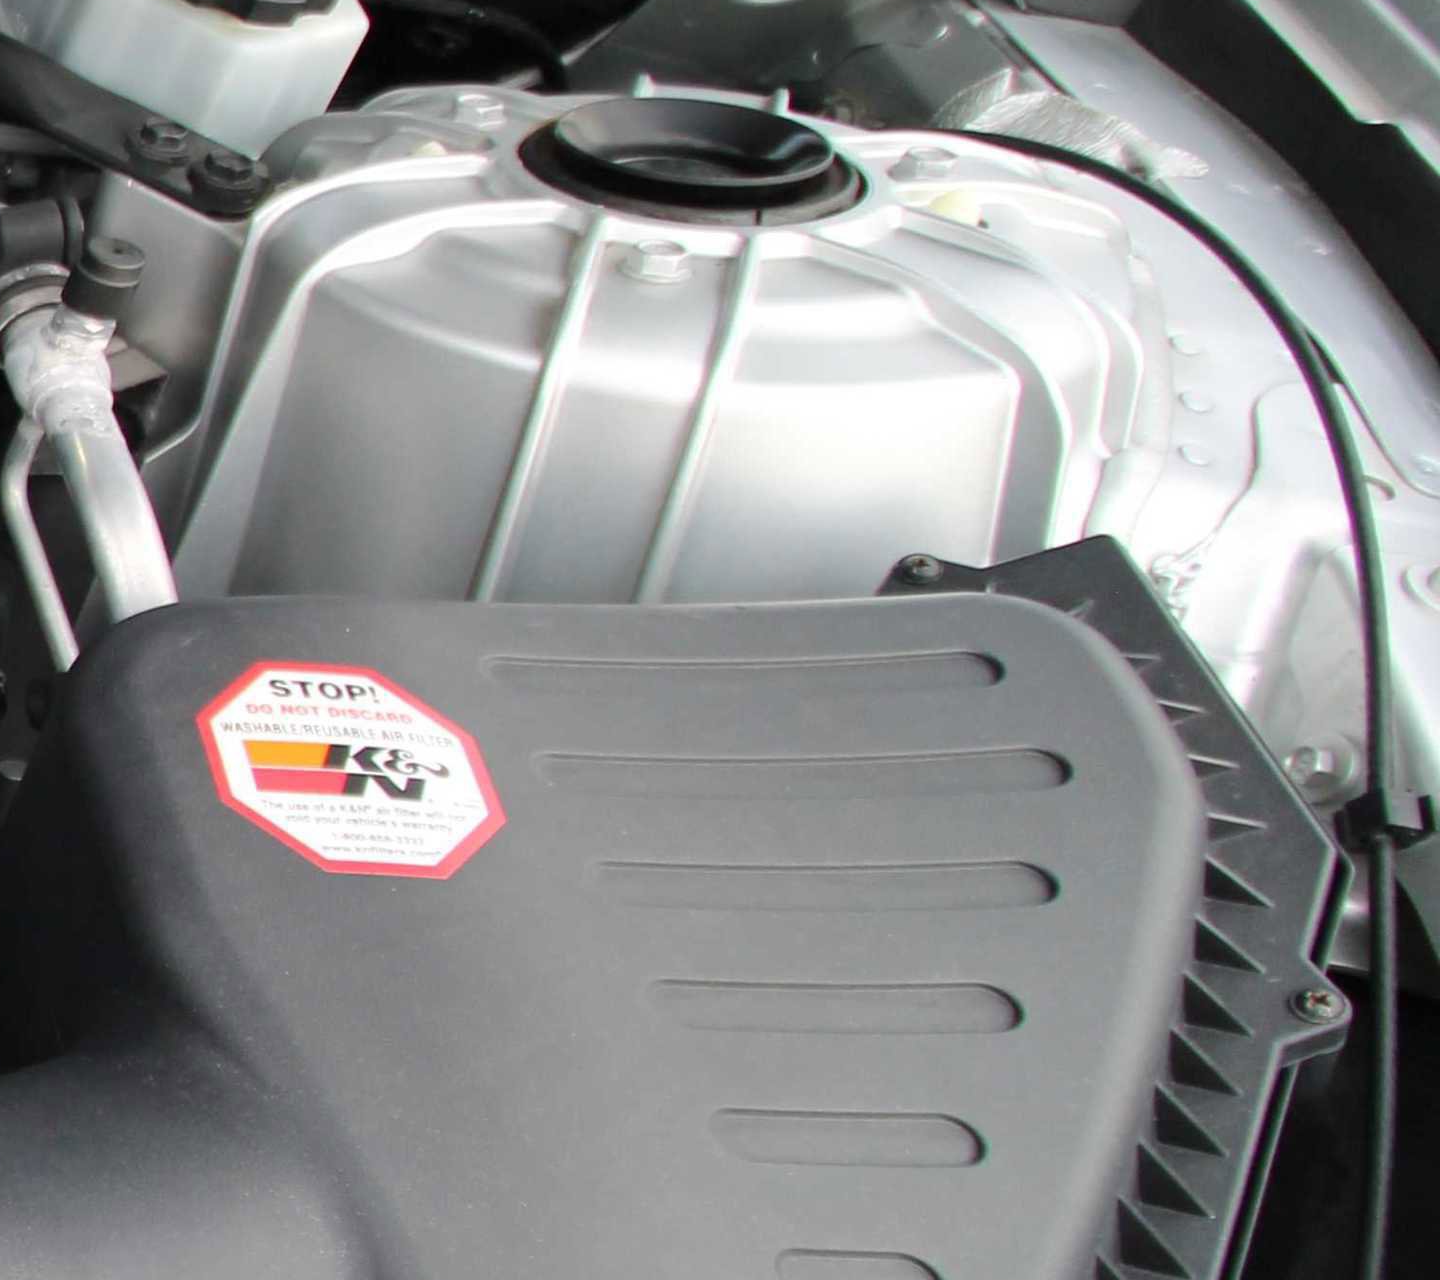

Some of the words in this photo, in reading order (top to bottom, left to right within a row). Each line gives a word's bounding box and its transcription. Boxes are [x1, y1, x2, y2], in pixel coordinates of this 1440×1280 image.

[269, 679, 380, 703] STOP!
[246, 704, 273, 715] DO
[280, 704, 321, 717] NOT
[328, 707, 413, 725] DISCARD
[221, 721, 375, 740] WASHABLE/REUSABLE
[382, 729, 404, 742] AIR
[409, 732, 456, 748] FILTER
